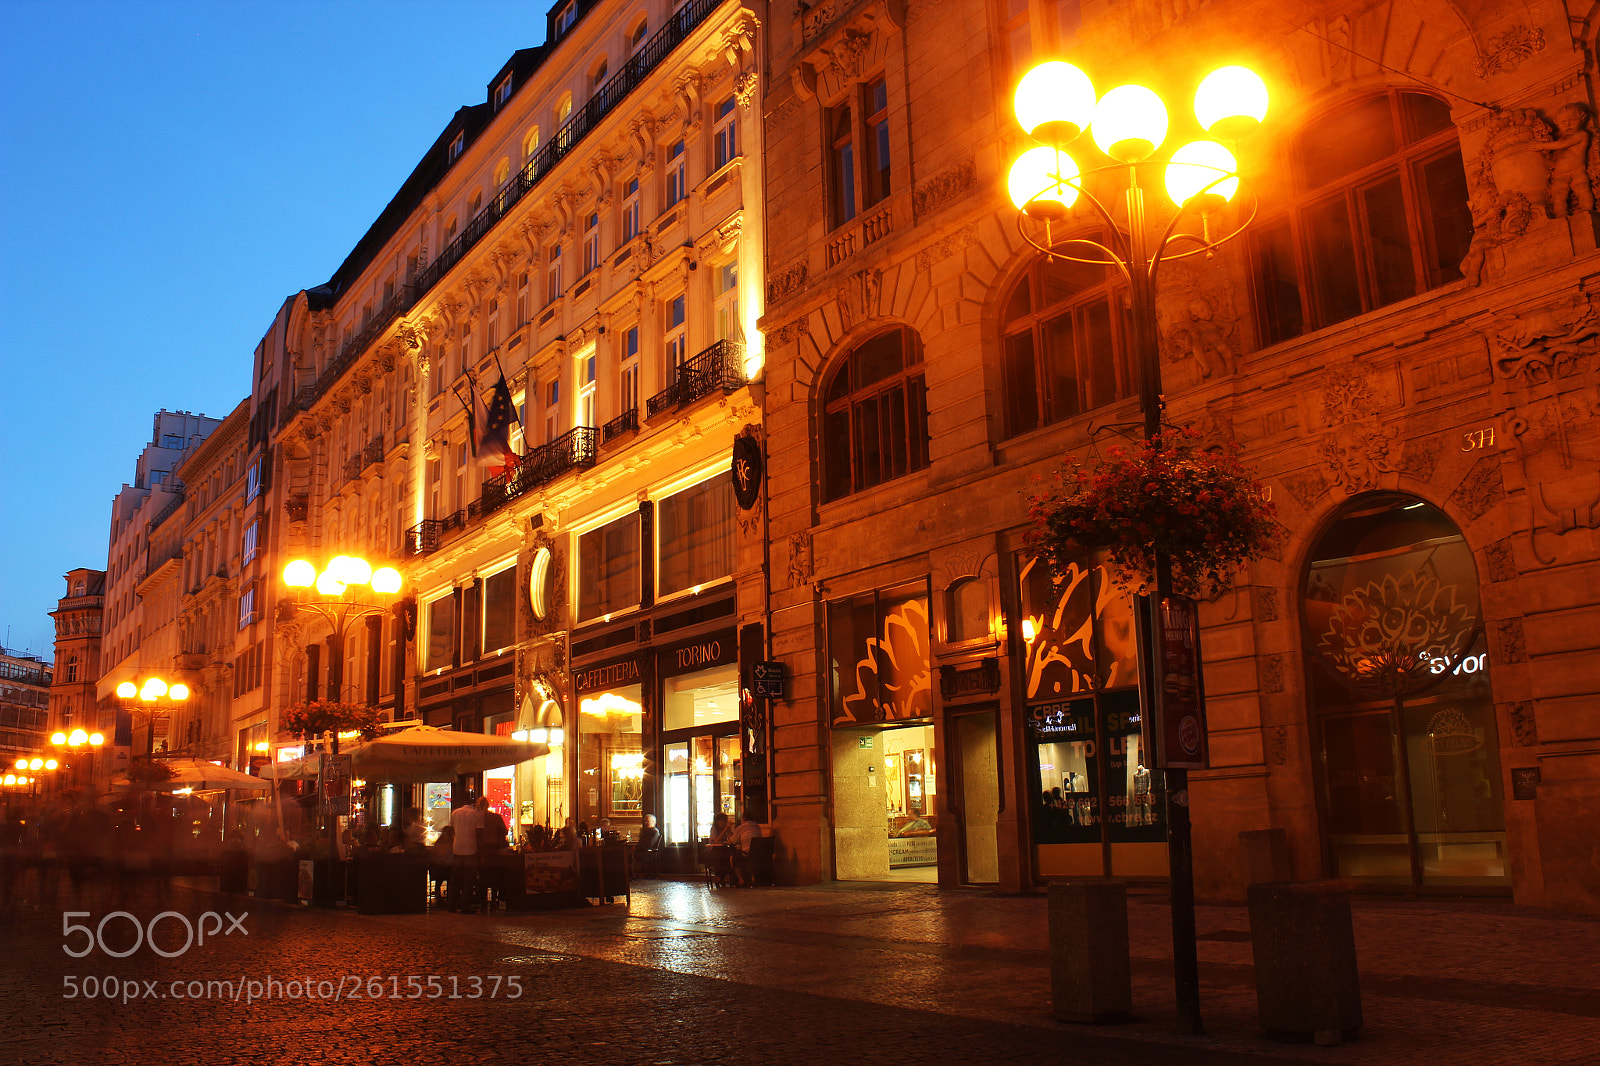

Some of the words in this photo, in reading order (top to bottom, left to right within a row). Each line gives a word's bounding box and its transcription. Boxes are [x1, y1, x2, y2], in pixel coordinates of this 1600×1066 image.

[1461, 427, 1496, 452] 377
[675, 640, 721, 669] TORINO
[575, 659, 640, 691] CAFFETTERIA
[1033, 702, 1072, 720] CBRE
[1070, 739, 1097, 760] TO
[1109, 795, 1129, 808] 566
